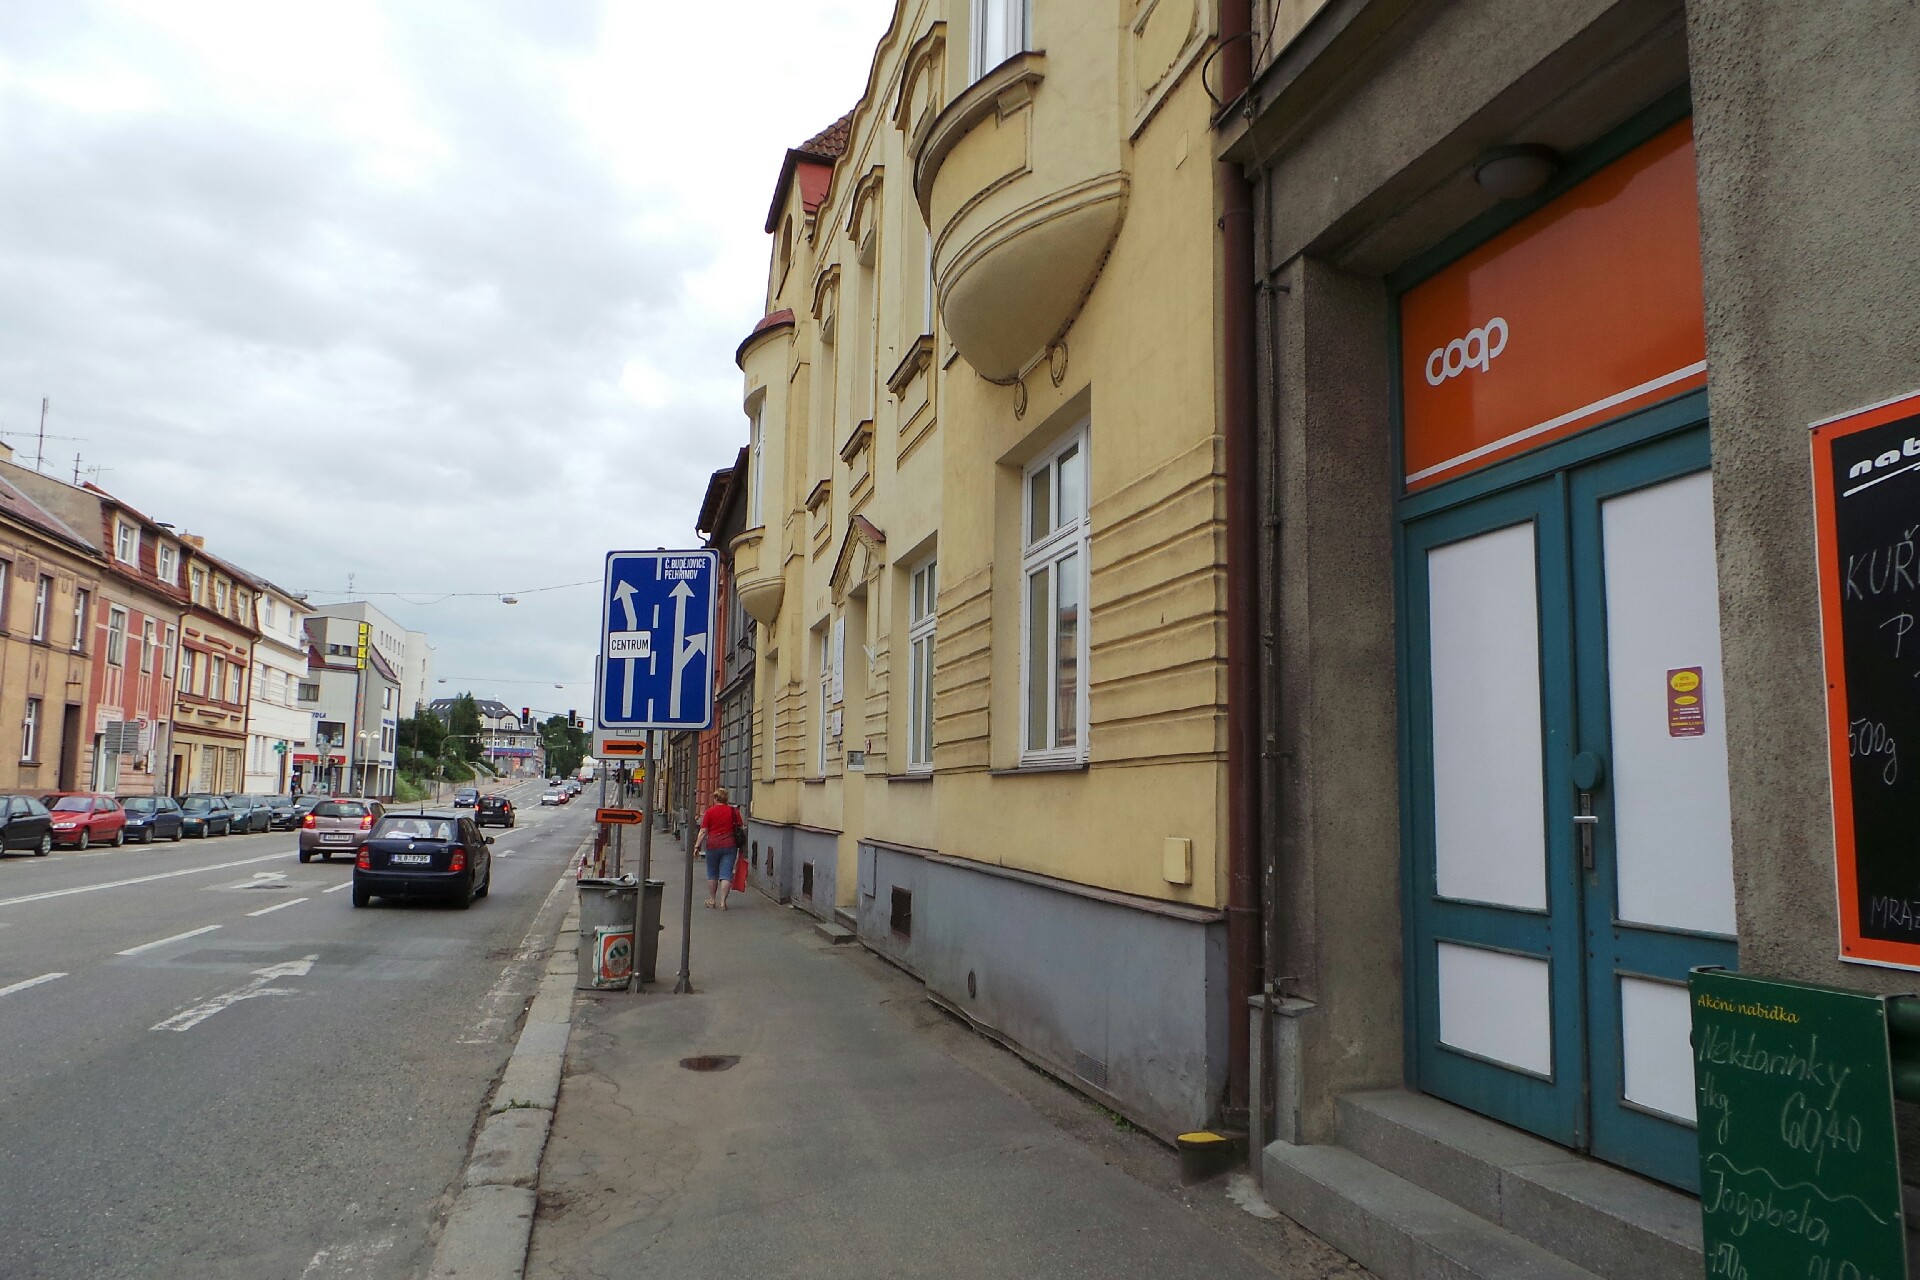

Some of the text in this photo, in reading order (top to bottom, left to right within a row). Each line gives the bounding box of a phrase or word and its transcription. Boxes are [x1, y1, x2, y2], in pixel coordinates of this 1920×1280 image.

[1425, 316, 1509, 386] coop
[664, 569, 698, 580] PELHŘIMOV
[1846, 524, 1920, 601] KUŘ
[611, 638, 649, 652] CENTRUM
[1848, 718, 1898, 786] 500g
[1699, 1024, 1851, 1111] Nektarinky
[1704, 1169, 1830, 1246] Jogobela
